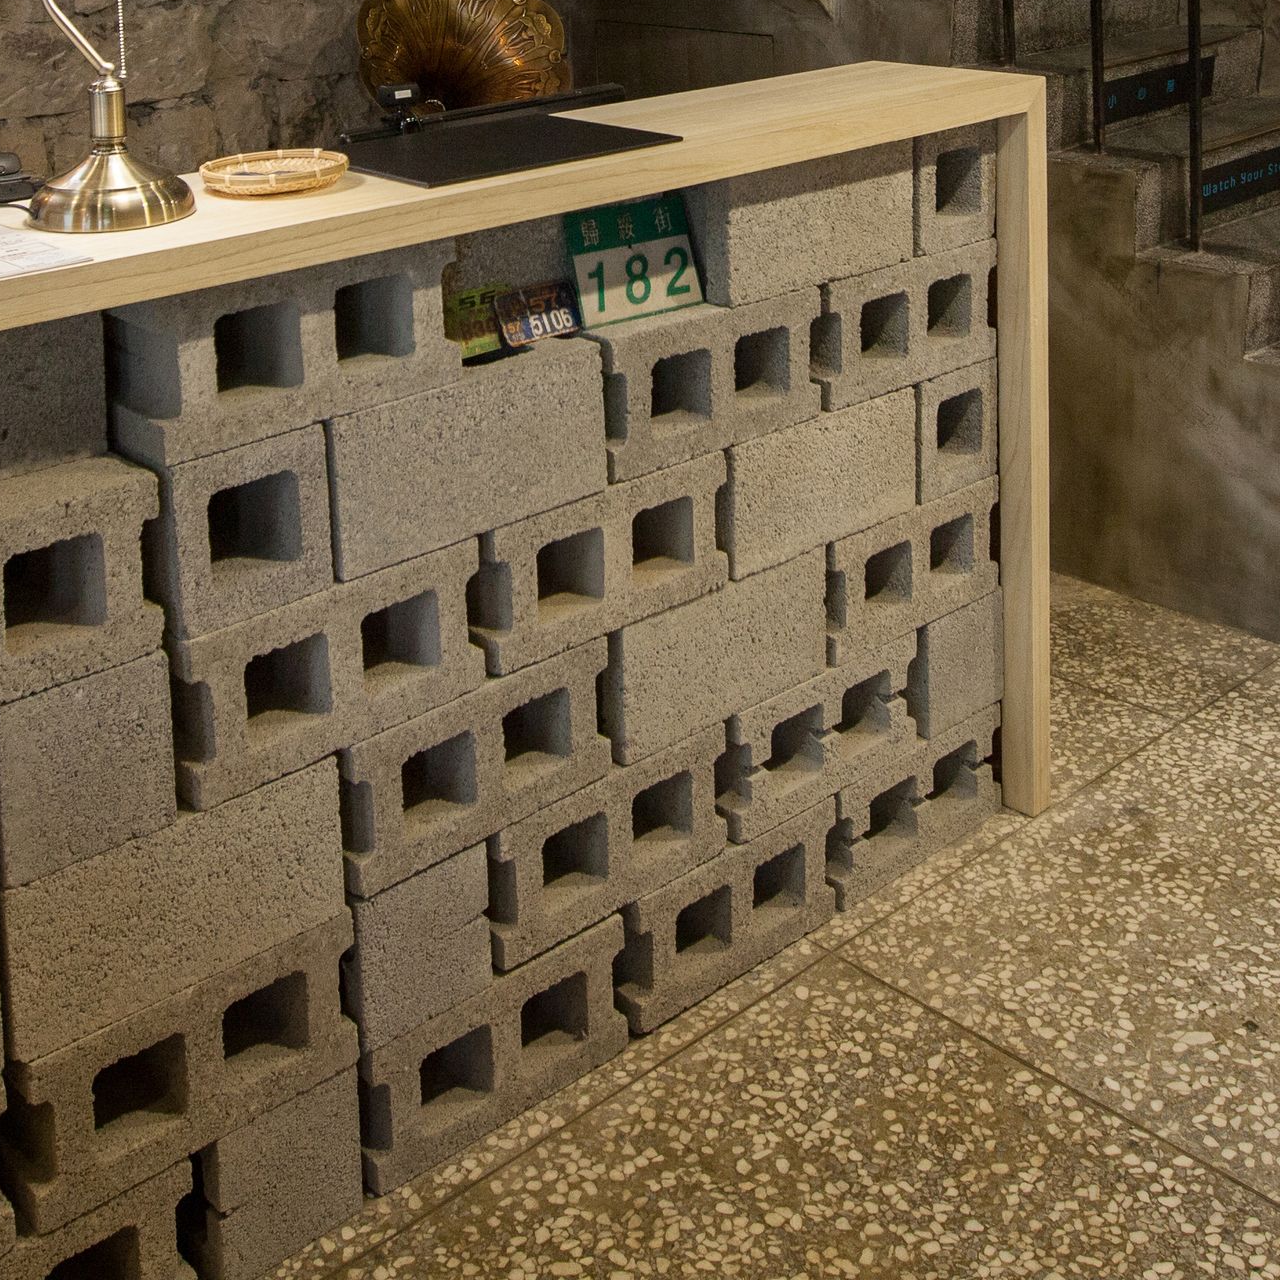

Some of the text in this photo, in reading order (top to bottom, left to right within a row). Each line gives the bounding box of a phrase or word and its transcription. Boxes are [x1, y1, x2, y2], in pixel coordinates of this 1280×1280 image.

[1202, 176, 1236, 197] Watch
[1240, 168, 1264, 184] Your
[580, 206, 673, 248] 歸綏街
[587, 246, 691, 314] 182
[529, 307, 573, 338] 5106
